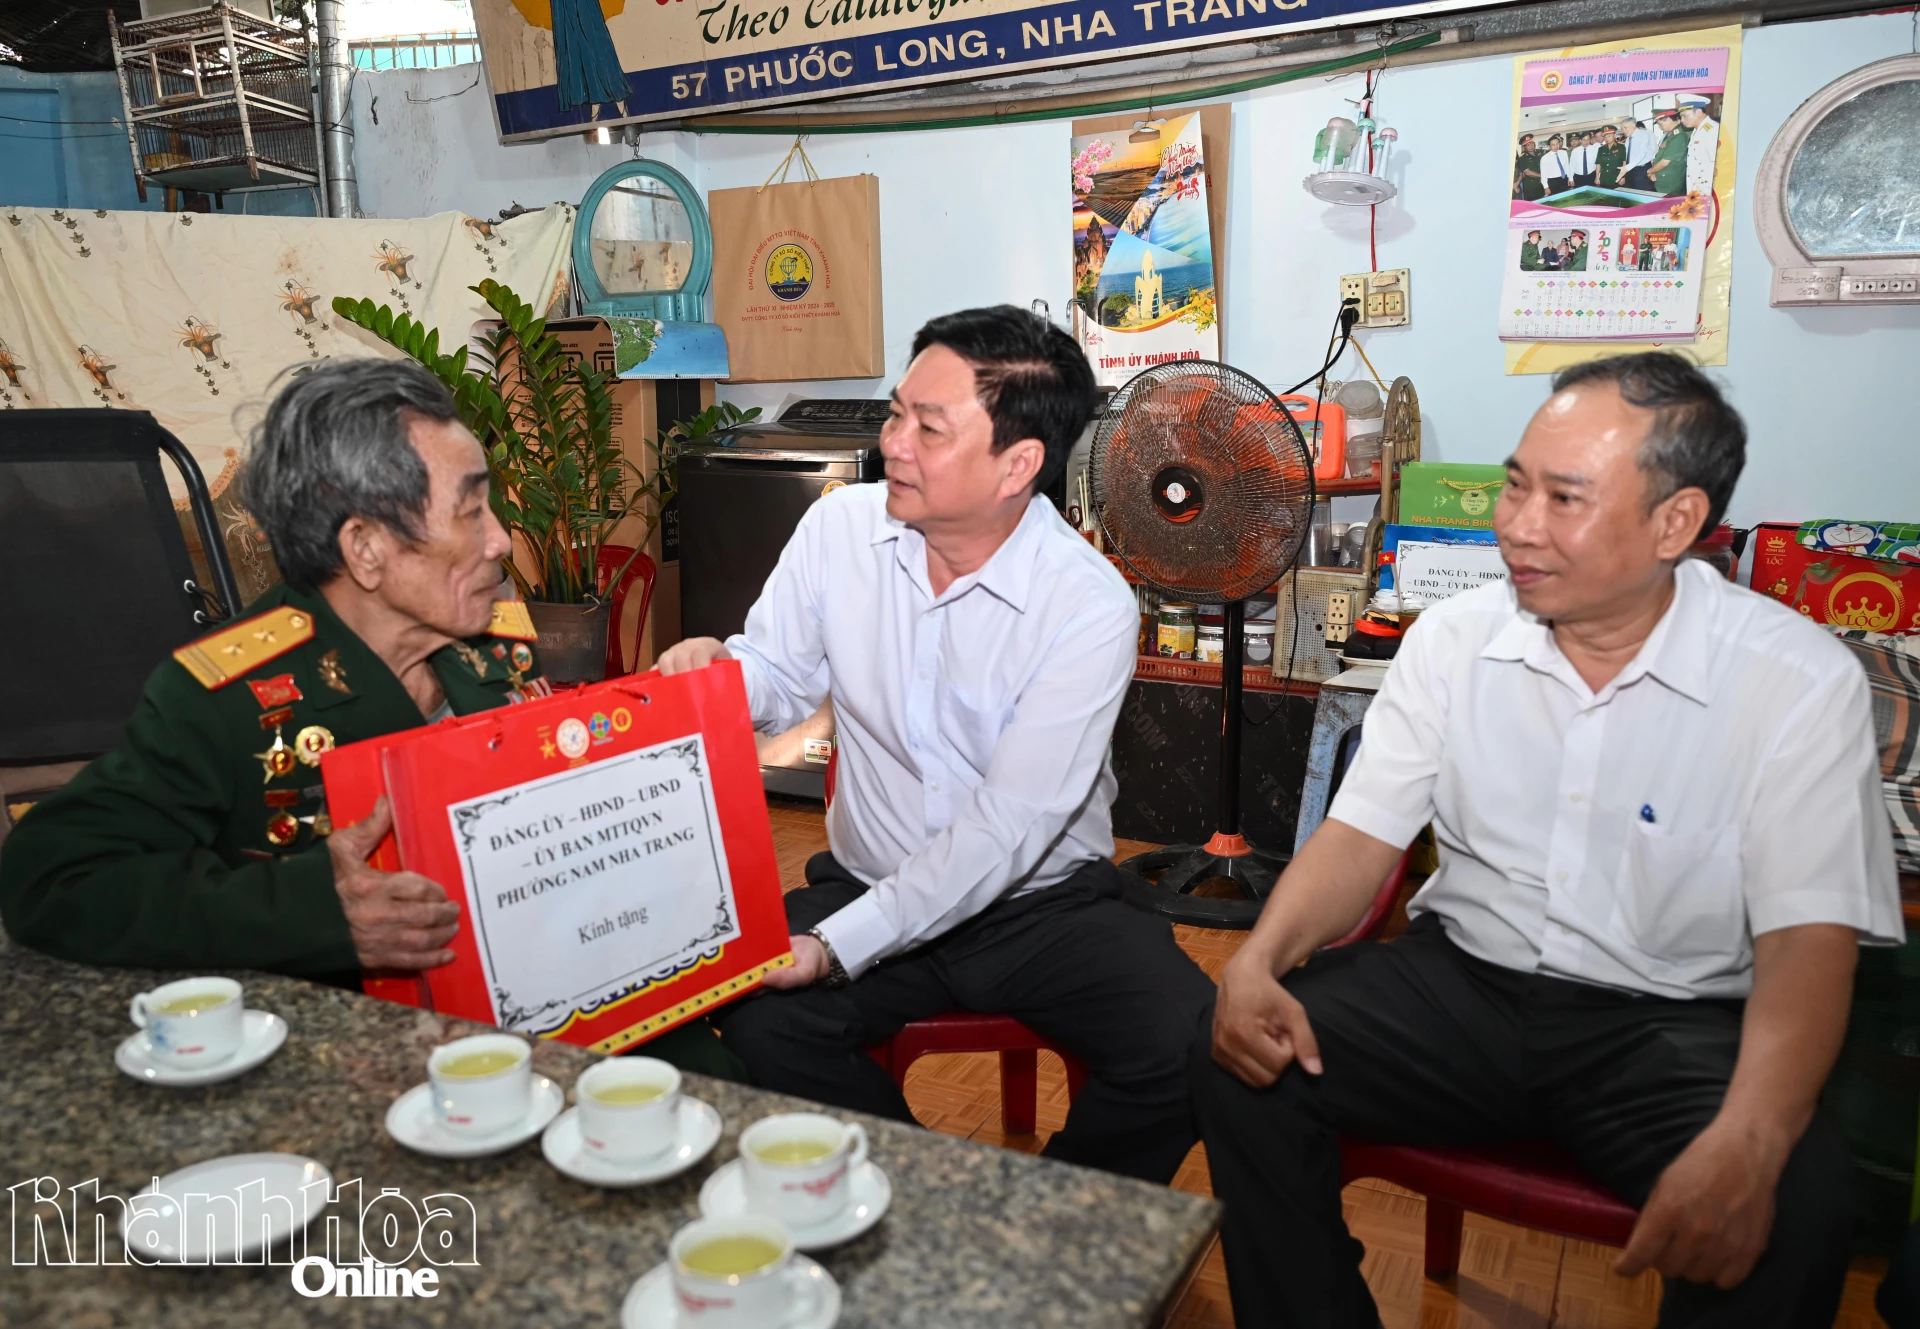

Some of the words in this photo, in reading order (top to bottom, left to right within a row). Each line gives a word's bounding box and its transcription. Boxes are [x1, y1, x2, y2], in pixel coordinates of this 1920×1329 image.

[696, 0, 789, 45] Theo
[804, 0, 985, 29] Catalog
[671, 72, 707, 100] 57
[724, 46, 854, 93] PHƯỚC
[874, 29, 1006, 71] LONG,
[1021, 10, 1117, 50] NHA
[1619, 72, 1631, 82] HUY
[1099, 354, 1125, 369] TỈNH
[1128, 352, 1142, 367] ỦY
[1145, 351, 1178, 366] KHÁNH
[1411, 515, 1433, 524] NHA
[1435, 516, 1470, 526] TRANG
[1413, 579, 1439, 588] UBND
[1428, 566, 1454, 577] ĐẢNG
[1846, 610, 1881, 629] LỘC
[489, 822, 541, 852] ĐẢNG
[542, 813, 565, 834] ỦY
[579, 795, 625, 822] HĐND
[638, 778, 681, 803] UBND
[534, 846, 557, 867] ỦY
[561, 834, 594, 858] BAN
[597, 809, 664, 844] MTTQVN
[496, 871, 568, 909] PHƯỜNG
[570, 858, 606, 882] NAM
[609, 847, 641, 869] NHA
[644, 826, 695, 856] TRANG
[578, 918, 615, 945] Kính
[618, 907, 649, 930] tặng
